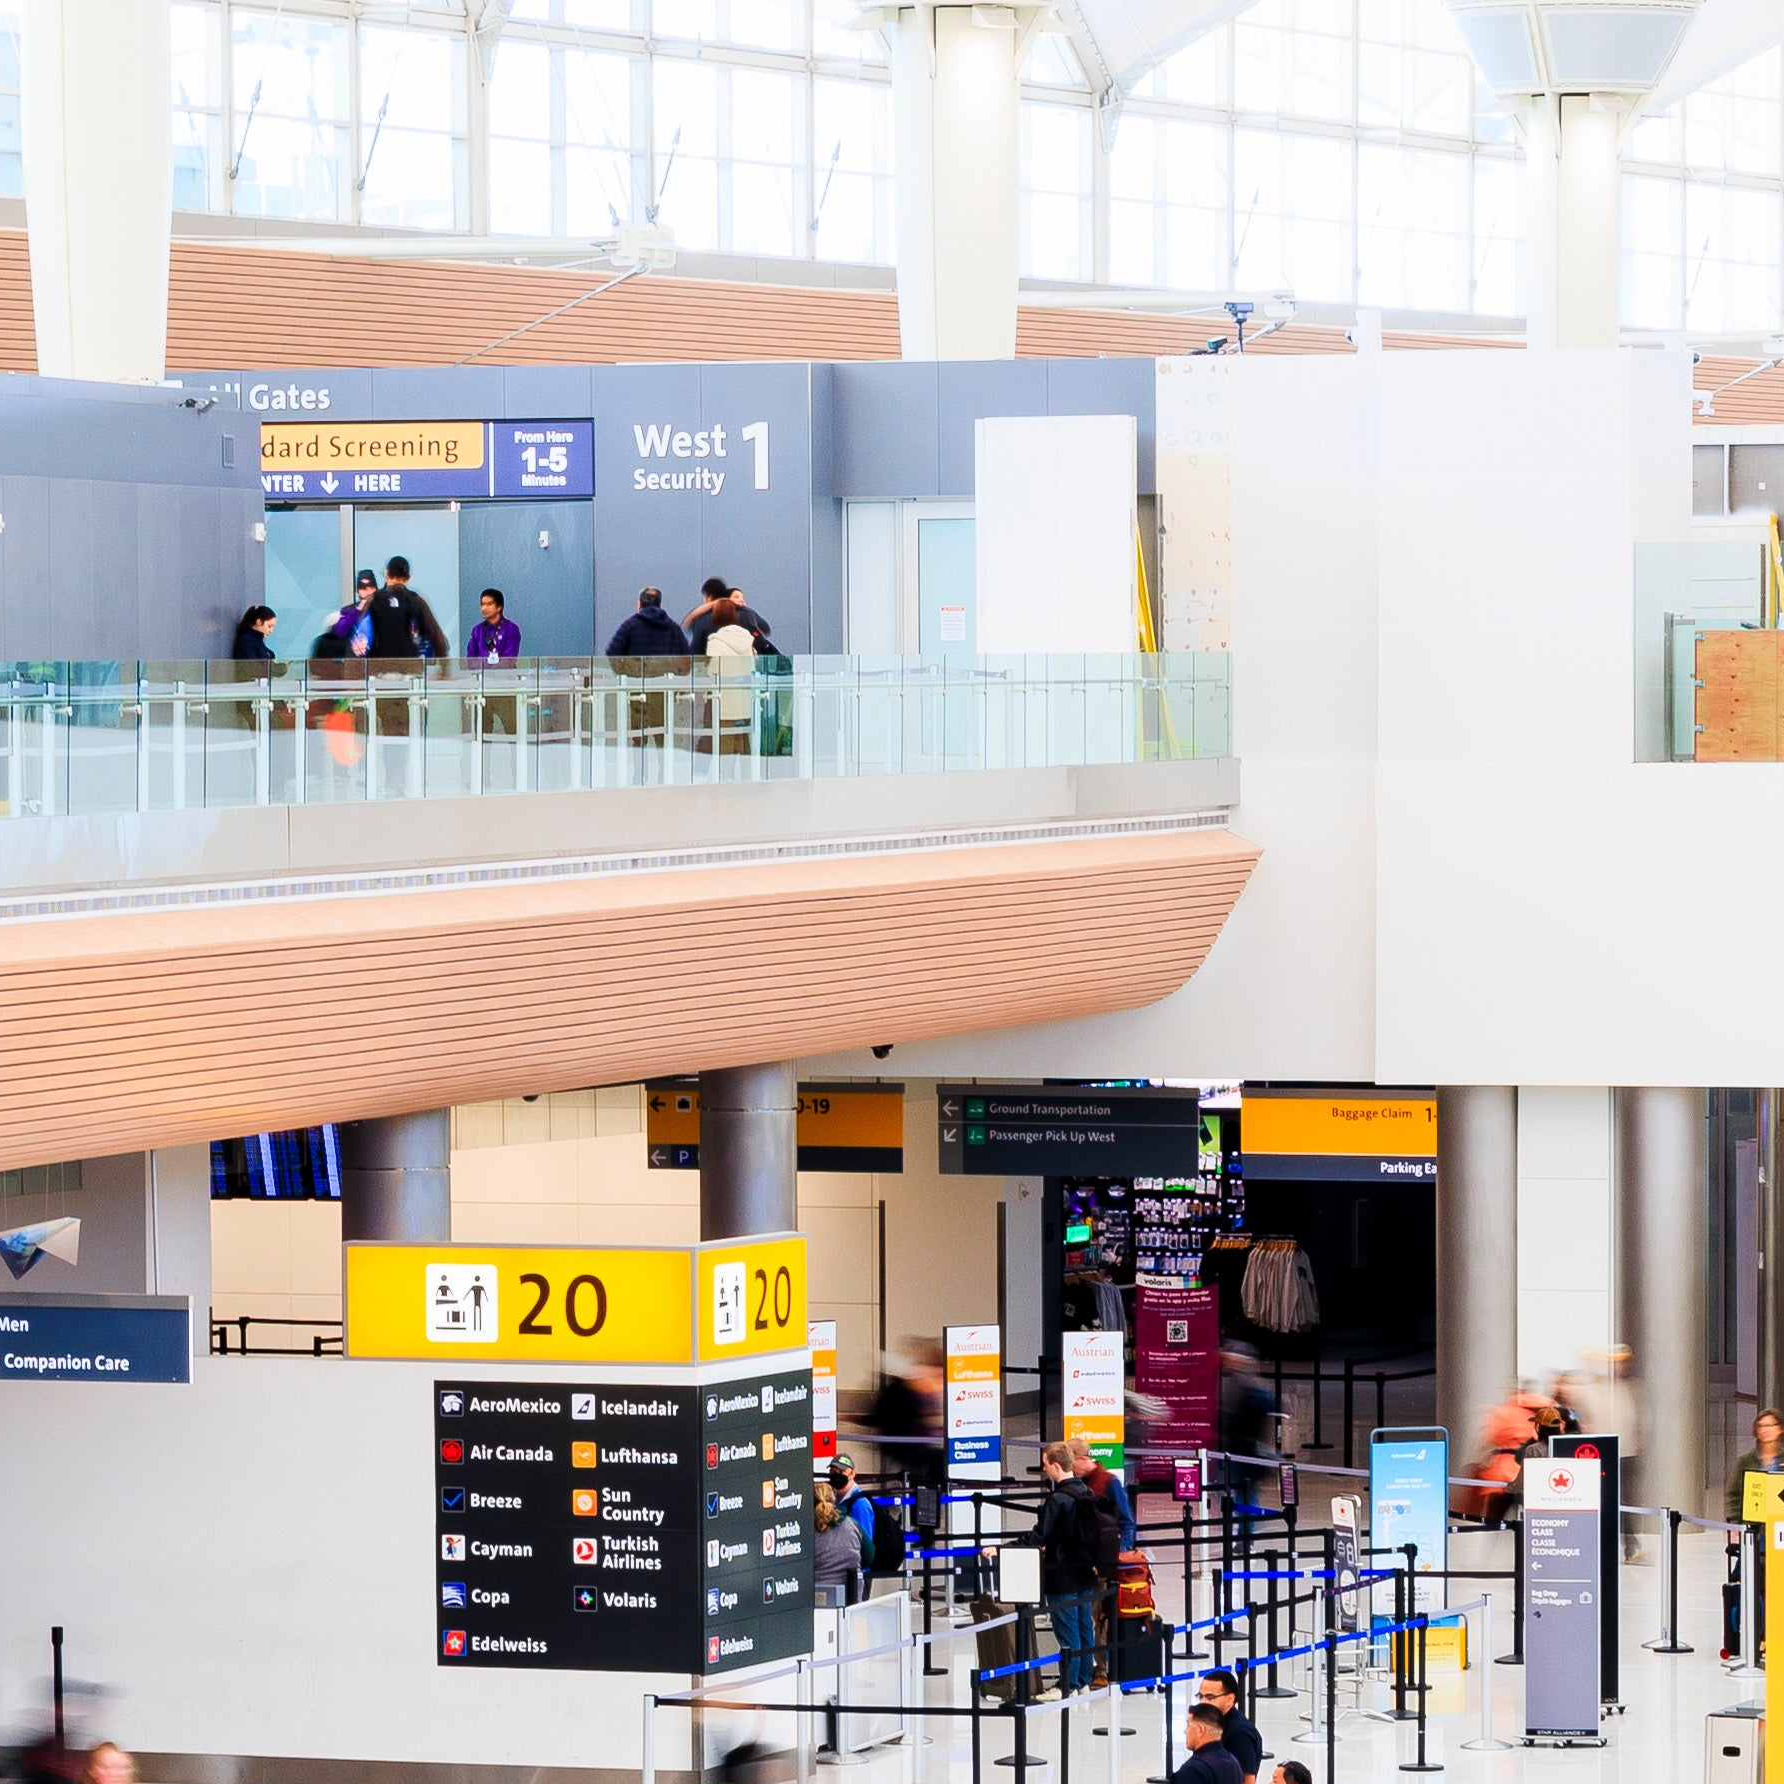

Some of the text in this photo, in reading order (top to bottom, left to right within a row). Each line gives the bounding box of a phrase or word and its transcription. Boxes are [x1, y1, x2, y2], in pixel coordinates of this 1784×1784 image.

[250, 384, 331, 411] Gates
[514, 431, 573, 444] From Here
[634, 424, 726, 458] West
[329, 432, 459, 462] Screening
[521, 448, 567, 472] 1-5
[742, 422, 769, 489] 1
[261, 474, 401, 493] NTER HERE
[521, 474, 566, 487] Minutes
[634, 468, 725, 495] Security
[990, 1104, 1110, 1116] Ground Transportation
[1333, 1108, 1412, 1121] Baggage Claim
[990, 1130, 1115, 1144] Passenger Pick Up West
[1381, 1162, 1423, 1176] Parking
[1144, 1278, 1172, 1286] volaris
[519, 1273, 608, 1337] 20
[754, 1266, 791, 1331] 20
[955, 1342, 992, 1352] Austrian
[1071, 1348, 1114, 1356] Austrian
[4, 1354, 129, 1372] Companion Care
[774, 1387, 807, 1404] Icelandair
[968, 1390, 993, 1398] SWISS
[1086, 1397, 1115, 1405] SWISS
[470, 1398, 560, 1414] AeroMexico
[601, 1401, 679, 1417] Icelandair
[719, 1394, 758, 1412] AeroMexico
[775, 1434, 807, 1452] Lufthansa
[954, 1441, 989, 1449] Business
[471, 1446, 553, 1461] Air Canada
[601, 1449, 678, 1465] Lufthansa
[720, 1443, 756, 1461] Air Canada
[954, 1451, 976, 1460] Class
[775, 1477, 788, 1492] Sun
[470, 1494, 522, 1509] Breeze
[602, 1489, 630, 1503] Sun
[720, 1494, 743, 1511] Breeze
[775, 1493, 802, 1510] Country
[602, 1507, 664, 1524] Country
[1531, 1519, 1569, 1527] ECONOMY
[775, 1522, 800, 1539] Turkish
[471, 1543, 532, 1559] Cayman
[602, 1537, 658, 1552] Turkish
[720, 1542, 748, 1562] Cayman
[775, 1539, 801, 1556] Airlines
[602, 1555, 661, 1570] Airlines
[775, 1578, 799, 1596] Volaris
[471, 1589, 510, 1607] Copa
[603, 1593, 657, 1608] Volaris
[720, 1591, 737, 1610] Copa
[471, 1637, 547, 1653] Edelweiss
[720, 1636, 753, 1655] Edelweiss
